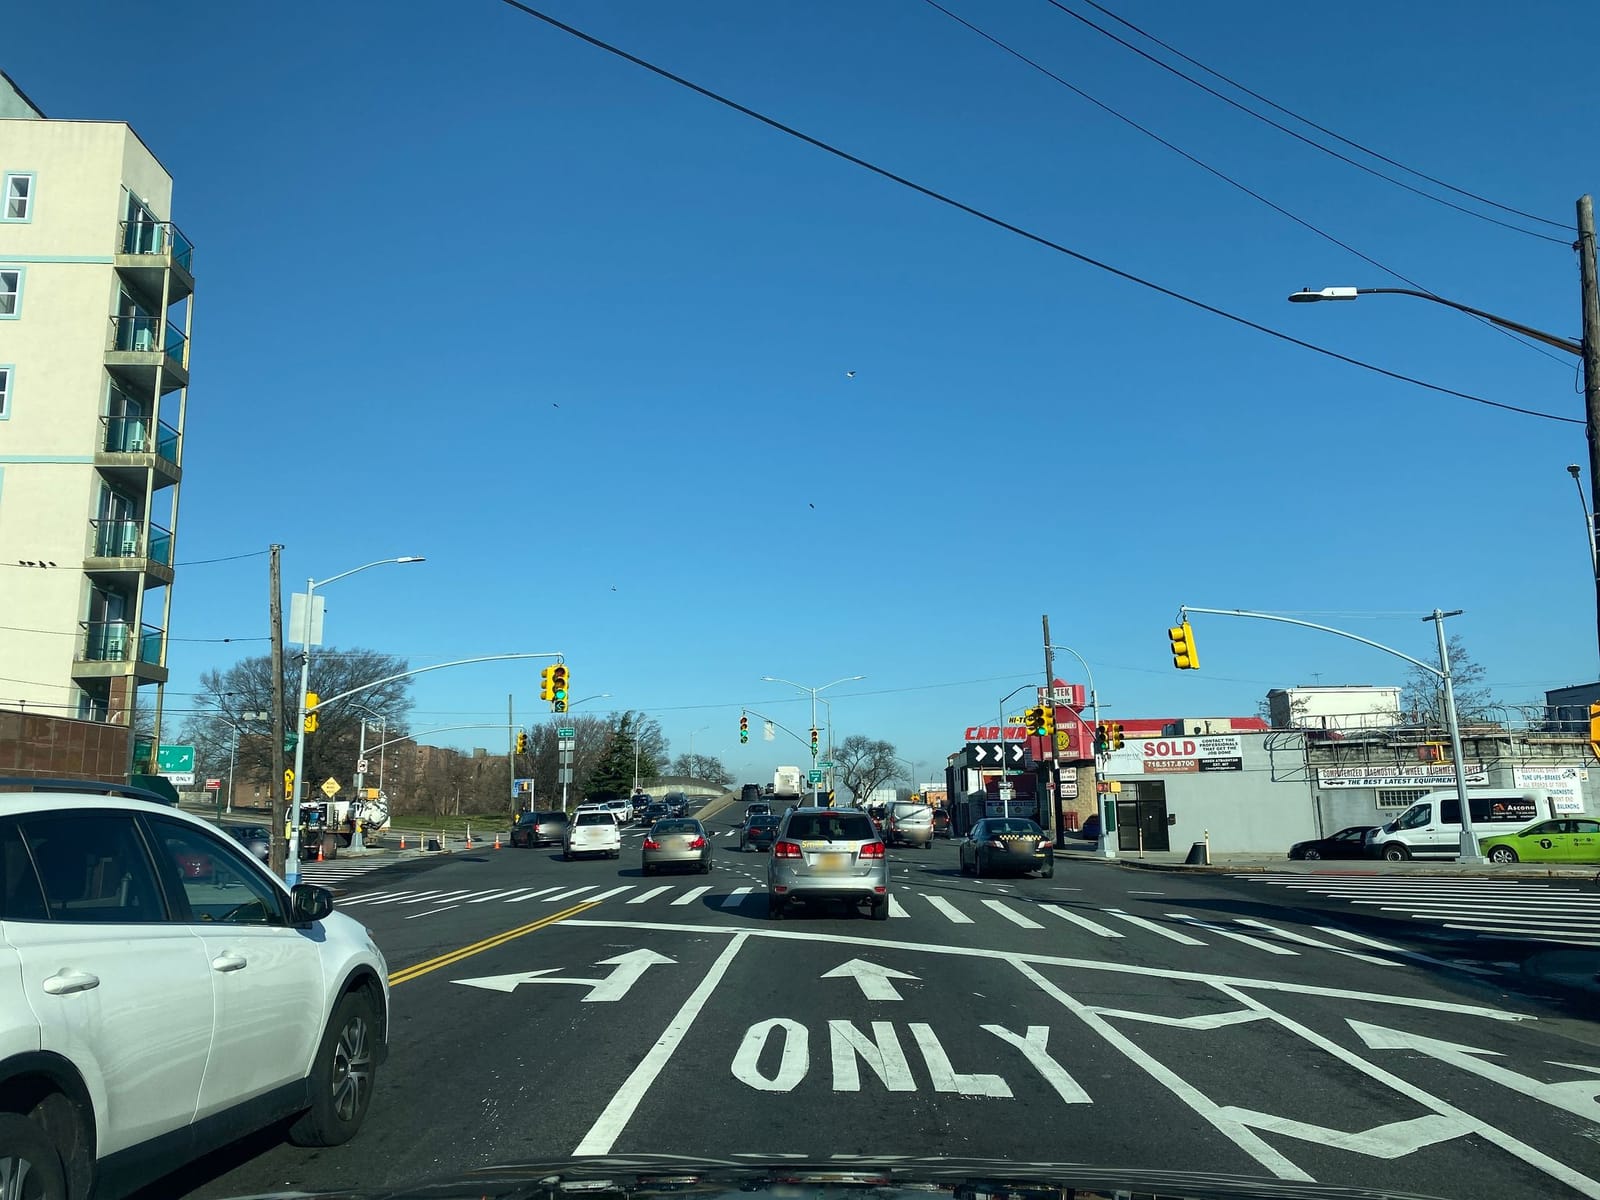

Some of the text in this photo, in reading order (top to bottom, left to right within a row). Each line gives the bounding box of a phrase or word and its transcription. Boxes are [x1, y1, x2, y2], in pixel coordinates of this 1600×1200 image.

[1044, 687, 1070, 697] H-TEK
[965, 727, 1027, 740] CAR WA
[1144, 741, 1196, 757] SOLD
[1323, 769, 1362, 777] COMPUTERIZED
[1405, 767, 1423, 776] WHEEL
[1427, 766, 1456, 775] ALIGNMEN
[731, 1017, 1093, 1104] ONLY
